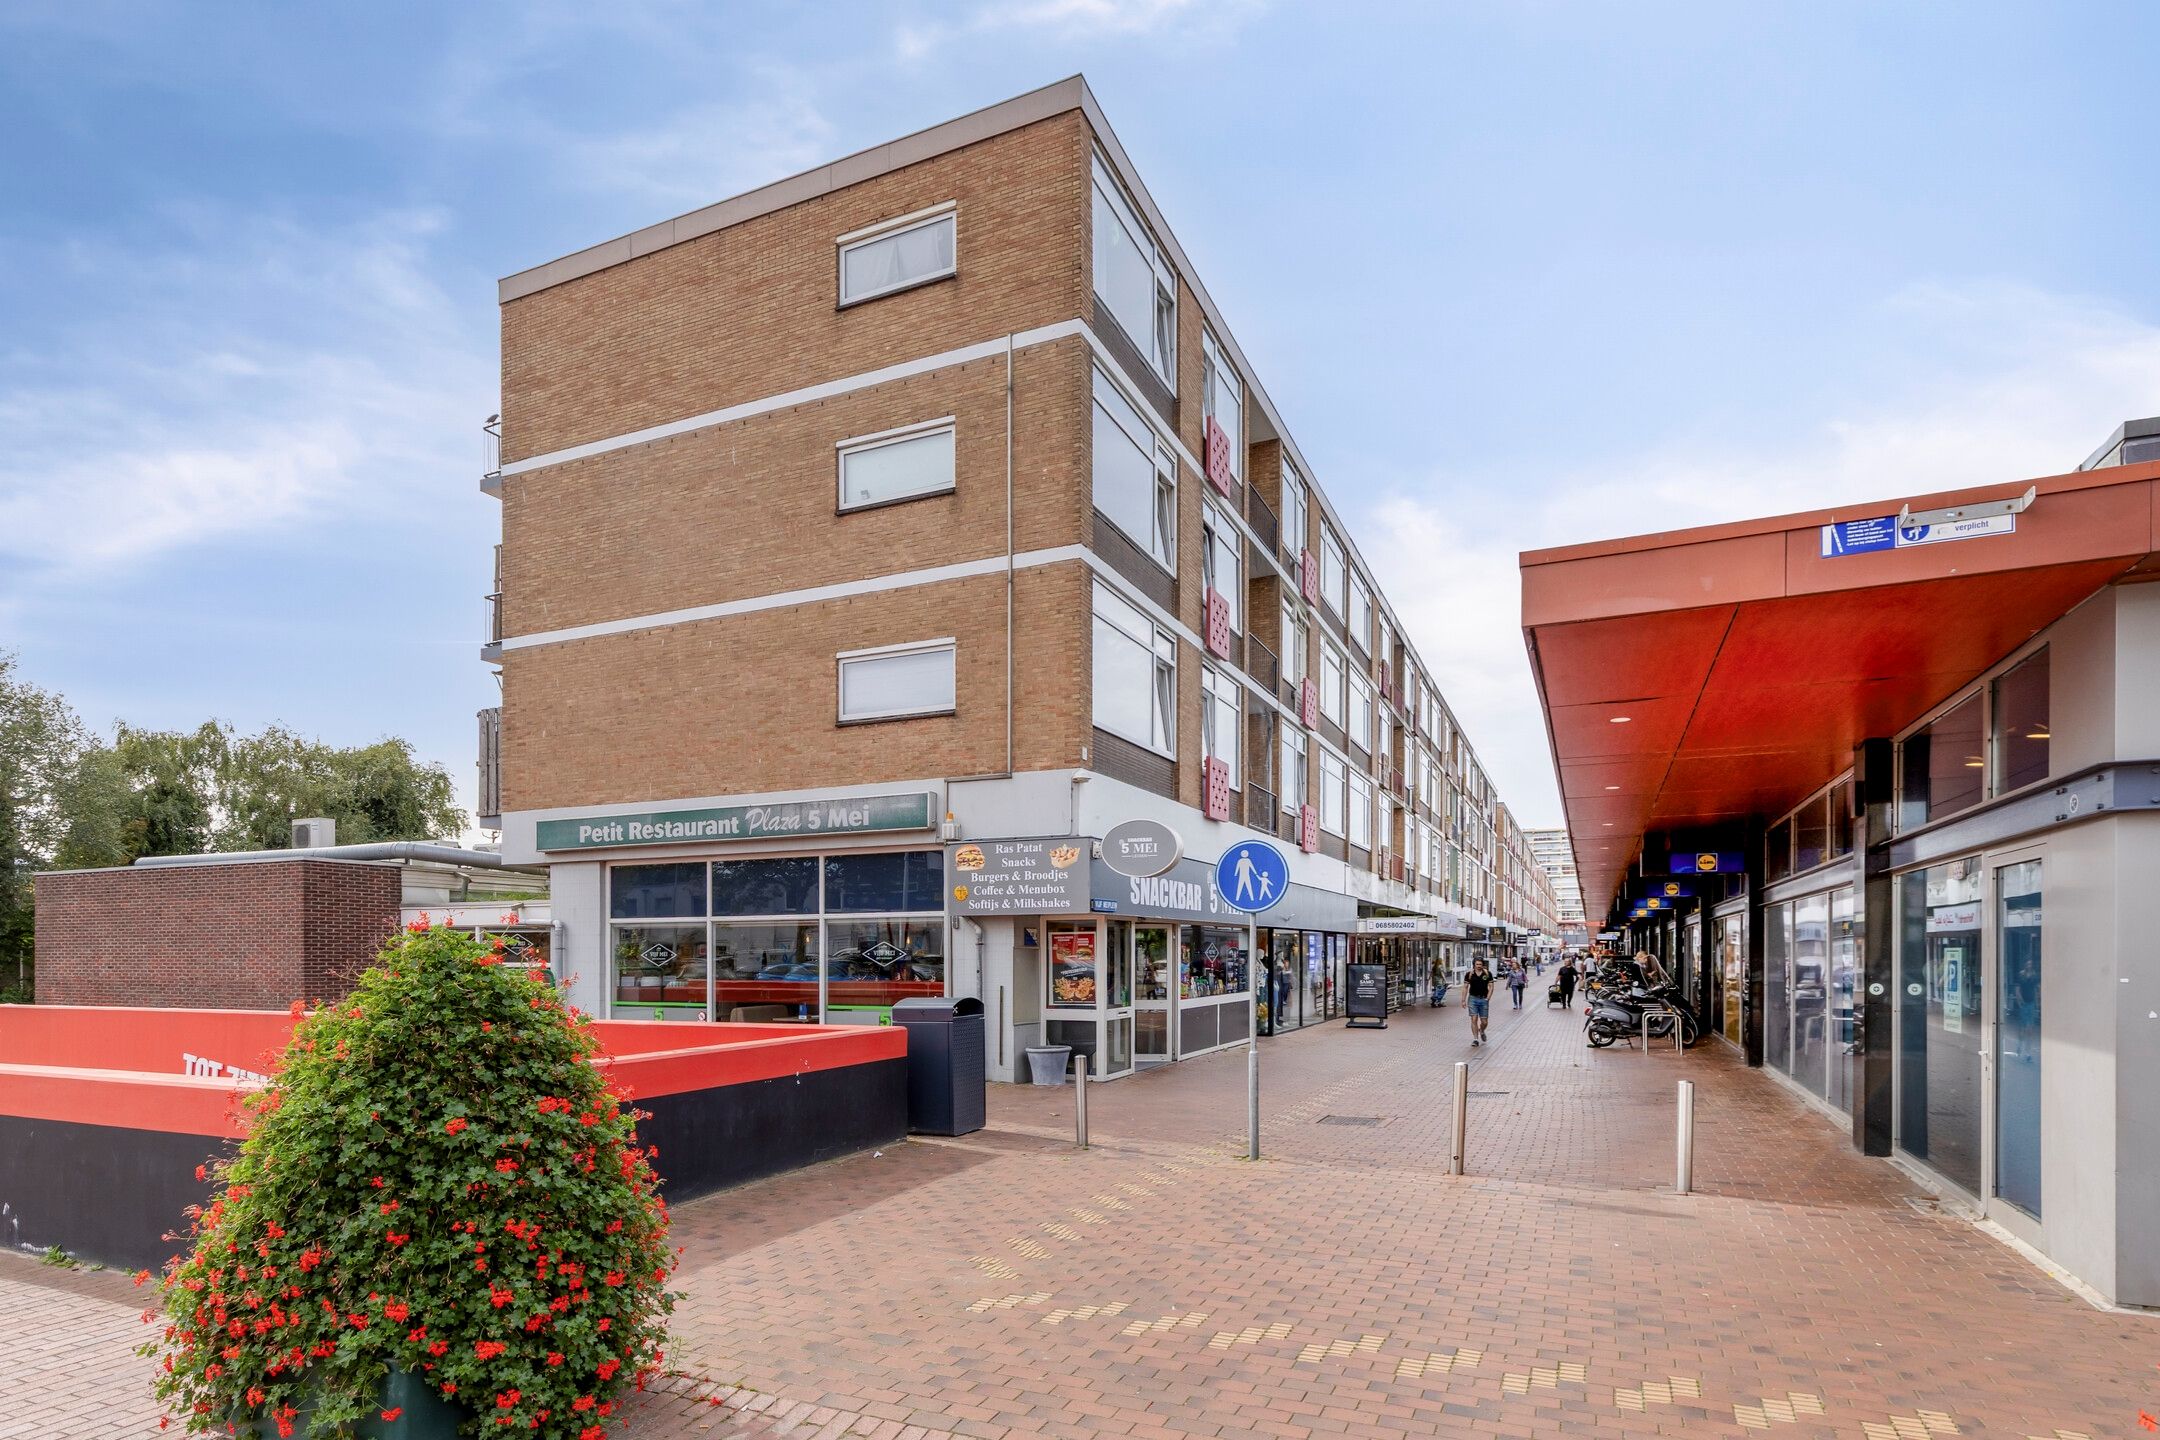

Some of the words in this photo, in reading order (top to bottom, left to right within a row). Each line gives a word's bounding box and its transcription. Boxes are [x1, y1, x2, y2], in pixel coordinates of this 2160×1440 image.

[1954, 520, 1989, 532] verplicht
[579, 821, 624, 843] Petit
[628, 816, 740, 840] Restaurant
[745, 807, 802, 835] Plaza
[808, 810, 821, 830] 5
[827, 804, 870, 828] Mei
[995, 844, 1014, 854] Ras
[1016, 843, 1042, 853] Patat
[1121, 843, 1129, 854] 5
[1133, 842, 1158, 853] MEI
[1001, 856, 1036, 868] Snacks
[971, 872, 1009, 884] Burgers
[1011, 871, 1021, 881] &
[1024, 869, 1069, 882] Broodjes
[973, 885, 1004, 896] Coffee
[1006, 885, 1016, 895] &
[1018, 884, 1065, 894] Menubox
[1130, 876, 1202, 912] SNACKBAR
[1209, 883, 1218, 914] 5
[968, 899, 999, 911] Softijs
[1001, 899, 1011, 909] &
[1014, 898, 1071, 909] Milkshakes
